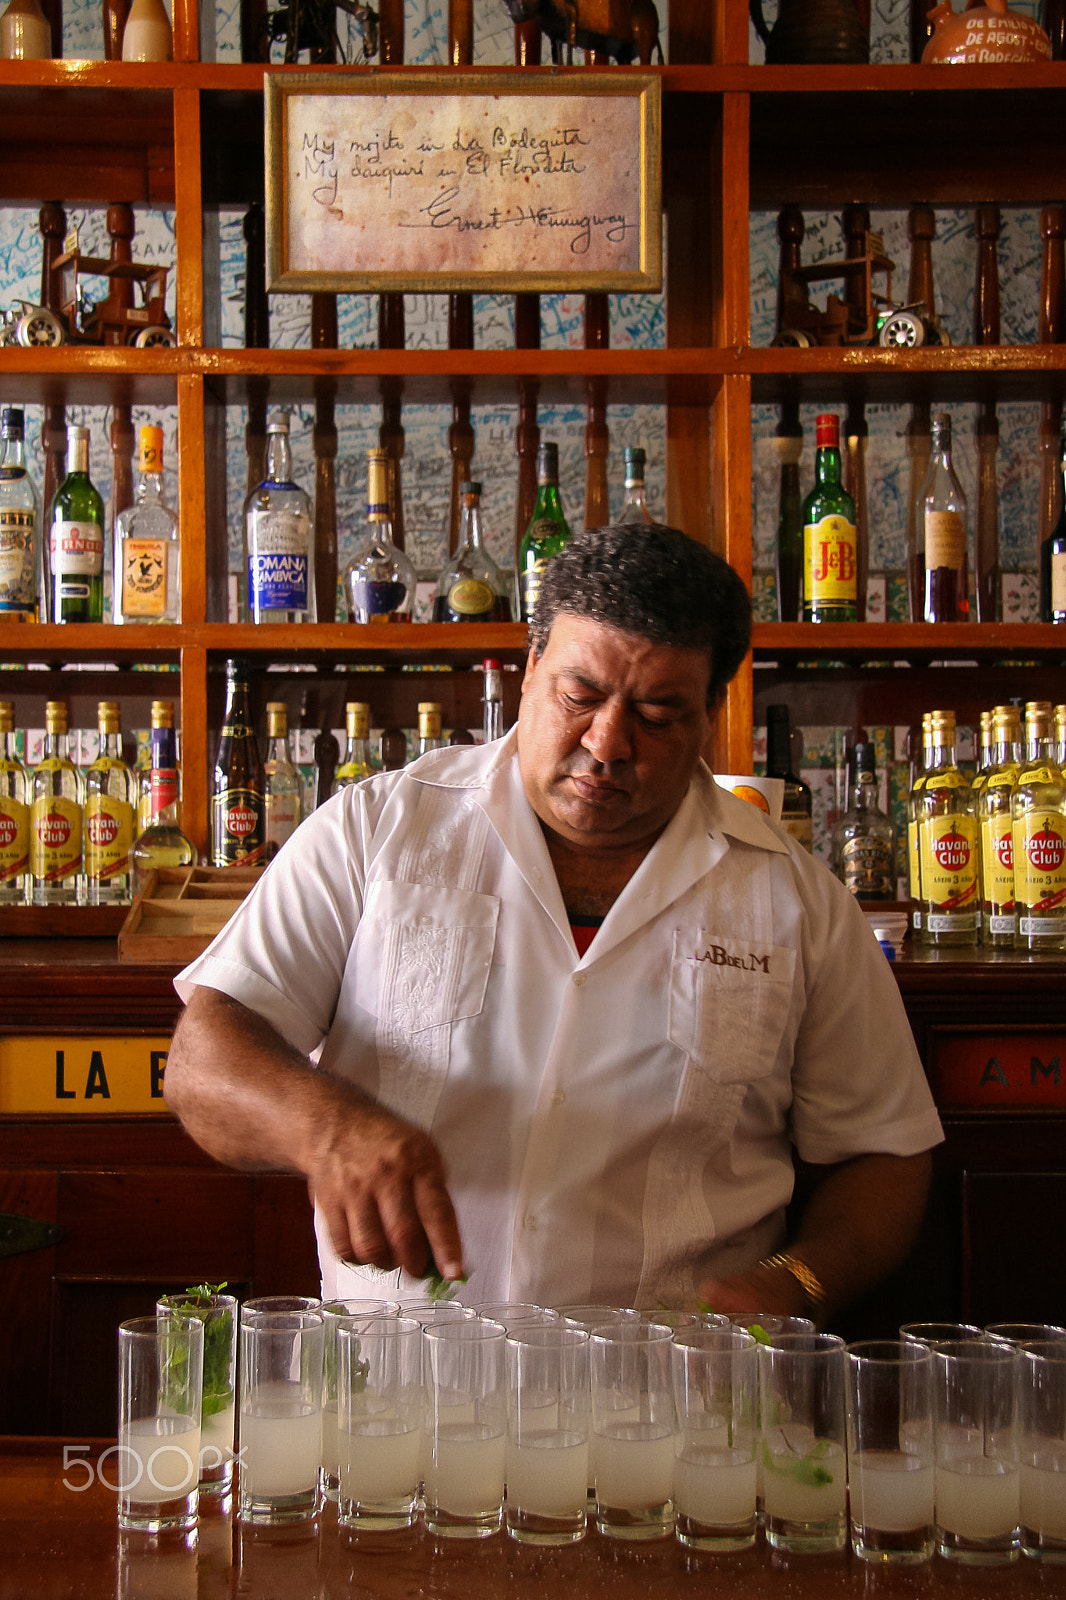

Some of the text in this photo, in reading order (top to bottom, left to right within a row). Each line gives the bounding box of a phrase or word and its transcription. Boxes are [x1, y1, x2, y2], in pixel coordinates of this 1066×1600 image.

[492, 126, 591, 157] Bodeguita
[304, 155, 338, 206] My
[466, 151, 490, 178] El
[500, 152, 587, 177] Floridita
[50, 539, 103, 554] PRNOD
[813, 541, 855, 582] J&B
[253, 570, 305, 583] AMBVCA
[229, 821, 252, 832] Club
[41, 830, 66, 842] Club
[90, 830, 113, 843] Club
[930, 838, 973, 851] Havana
[993, 837, 1013, 851] Hav
[939, 851, 967, 865] Club
[1031, 851, 1060, 865] Club
[953, 875, 960, 884] 3
[1045, 875, 1052, 885] 3
[55, 1050, 111, 1099] LA
